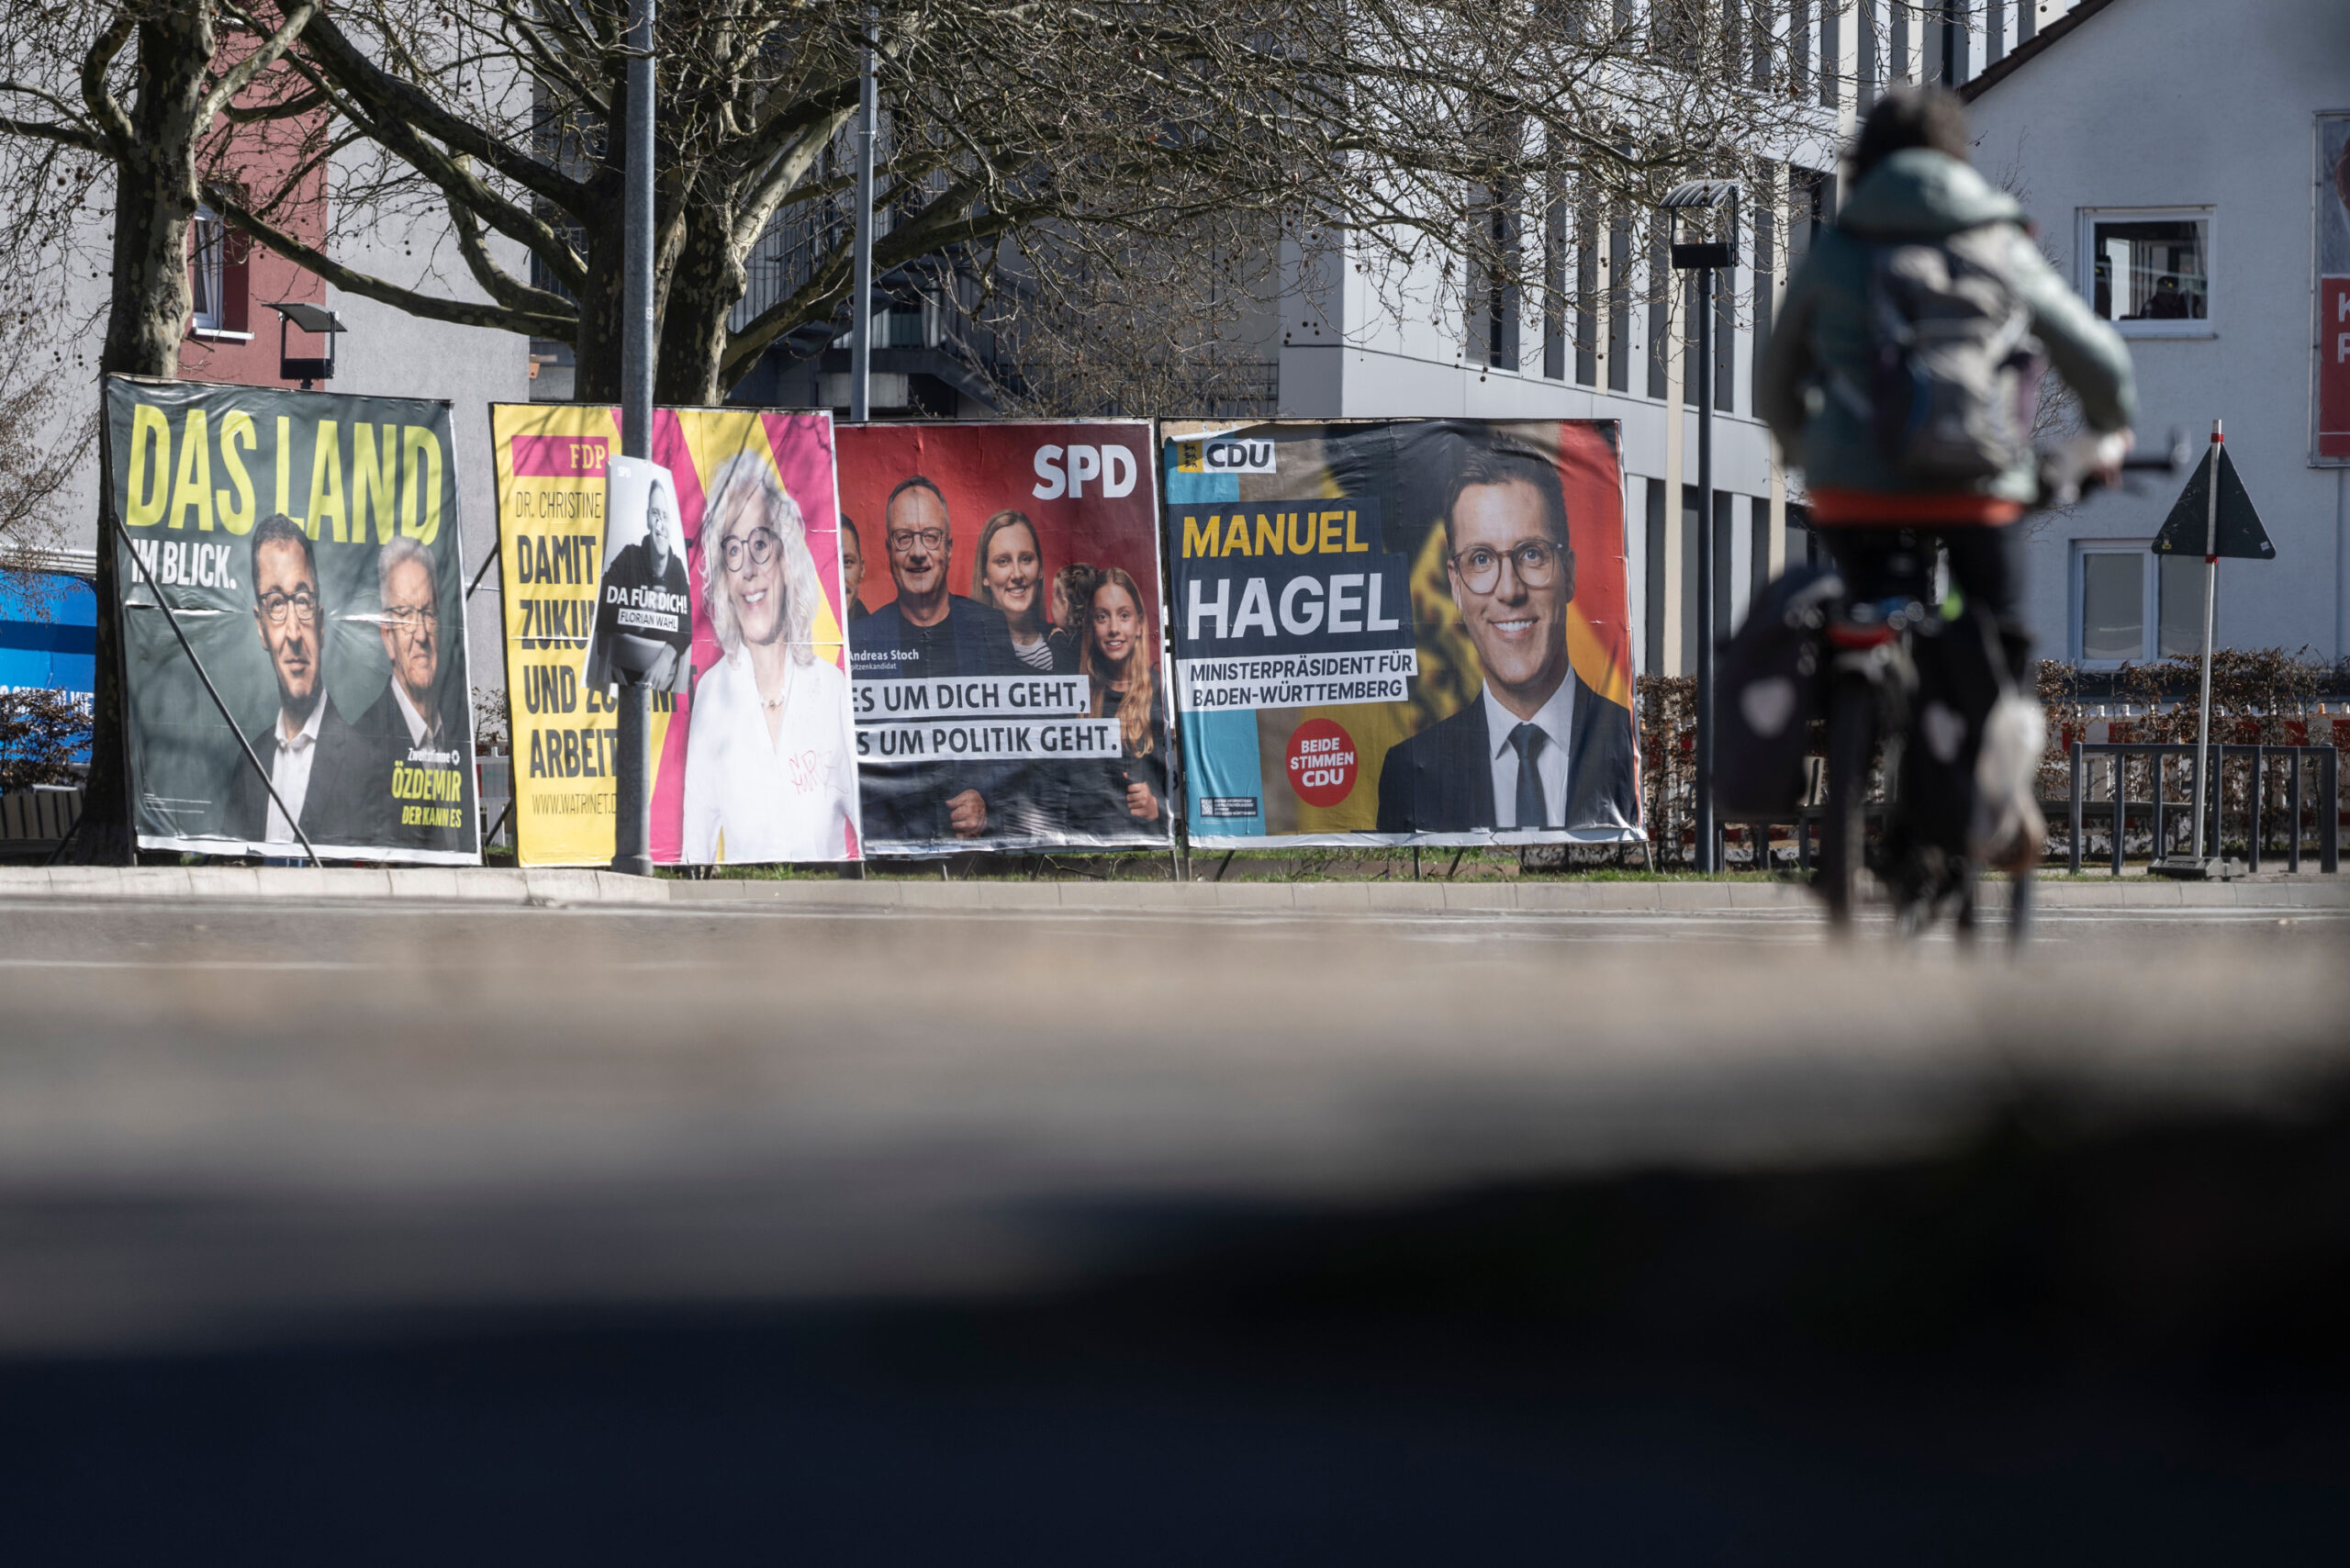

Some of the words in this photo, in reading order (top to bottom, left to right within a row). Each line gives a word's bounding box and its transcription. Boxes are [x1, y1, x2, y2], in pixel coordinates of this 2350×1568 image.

[569, 443, 606, 469] FDP
[1206, 443, 1271, 468] CDU
[126, 404, 257, 536] DAS
[275, 416, 442, 546] LAND
[1032, 444, 1137, 500] SPD
[515, 491, 535, 519] DR.
[539, 491, 602, 519] CHRISTINE
[1182, 510, 1369, 558] MANUEL
[131, 539, 158, 583] IM
[162, 541, 237, 589] BLICK.
[517, 535, 597, 585] DAMIT
[607, 585, 629, 606] DA
[631, 584, 656, 610] FÜR
[658, 592, 688, 614] DICH!
[1188, 573, 1399, 640] HAGEL
[621, 611, 654, 625] FLORIAN
[655, 616, 677, 630] WAHL
[850, 662, 897, 671] pitzenkandidat
[890, 648, 920, 660] Stoch
[1191, 655, 1375, 682] MINISTERPRÄSIDENT
[1379, 650, 1412, 674] FÜR
[523, 665, 577, 714] UND
[884, 685, 929, 711] UM
[936, 683, 1000, 710] DICH
[1008, 682, 1087, 712] GEHT,
[1192, 679, 1403, 707] BADEN-WÜRTTEMBERG
[879, 730, 924, 755] UM
[933, 727, 1032, 753] POLITIK
[1040, 726, 1118, 752] GEHT.
[1301, 737, 1340, 754] BEIDE
[1290, 751, 1354, 770] STIMMEN
[391, 760, 462, 801] ÖZDEMIR
[1302, 768, 1344, 787] CDU
[401, 805, 422, 824] DER
[422, 807, 449, 826] KANN
[449, 809, 463, 828] ES
